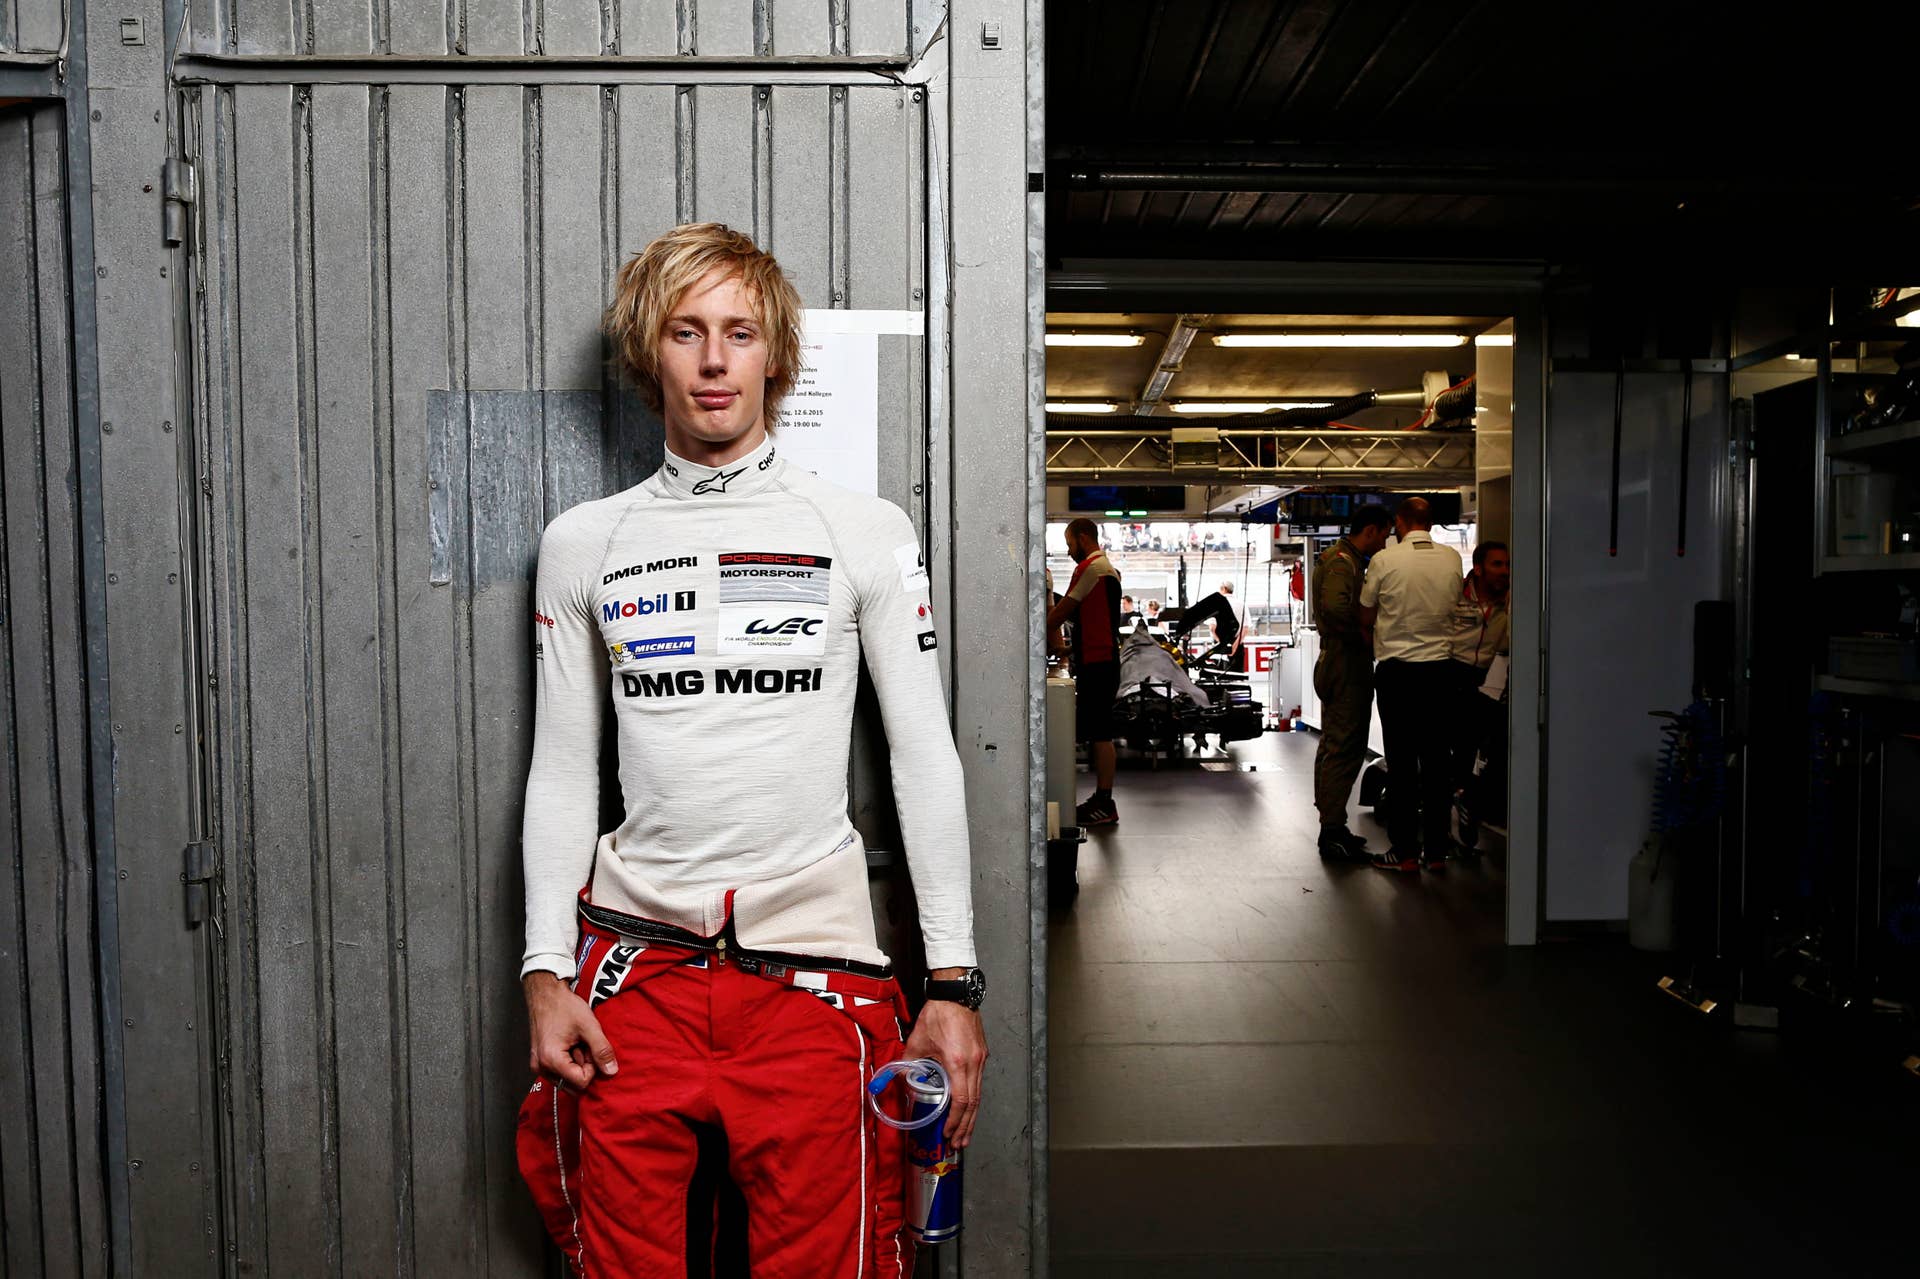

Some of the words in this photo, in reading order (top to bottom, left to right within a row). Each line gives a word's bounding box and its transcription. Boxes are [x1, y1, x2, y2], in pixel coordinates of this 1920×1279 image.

[719, 554, 816, 566] PORSCHE
[603, 565, 643, 586] DMG
[646, 556, 698, 573] MORI
[720, 569, 815, 579] MOTORSPORT
[602, 593, 668, 624] Mobil
[745, 617, 824, 636] WEC
[634, 640, 693, 654] MICHELIN
[621, 670, 705, 698] DMG
[715, 667, 823, 694] MORI
